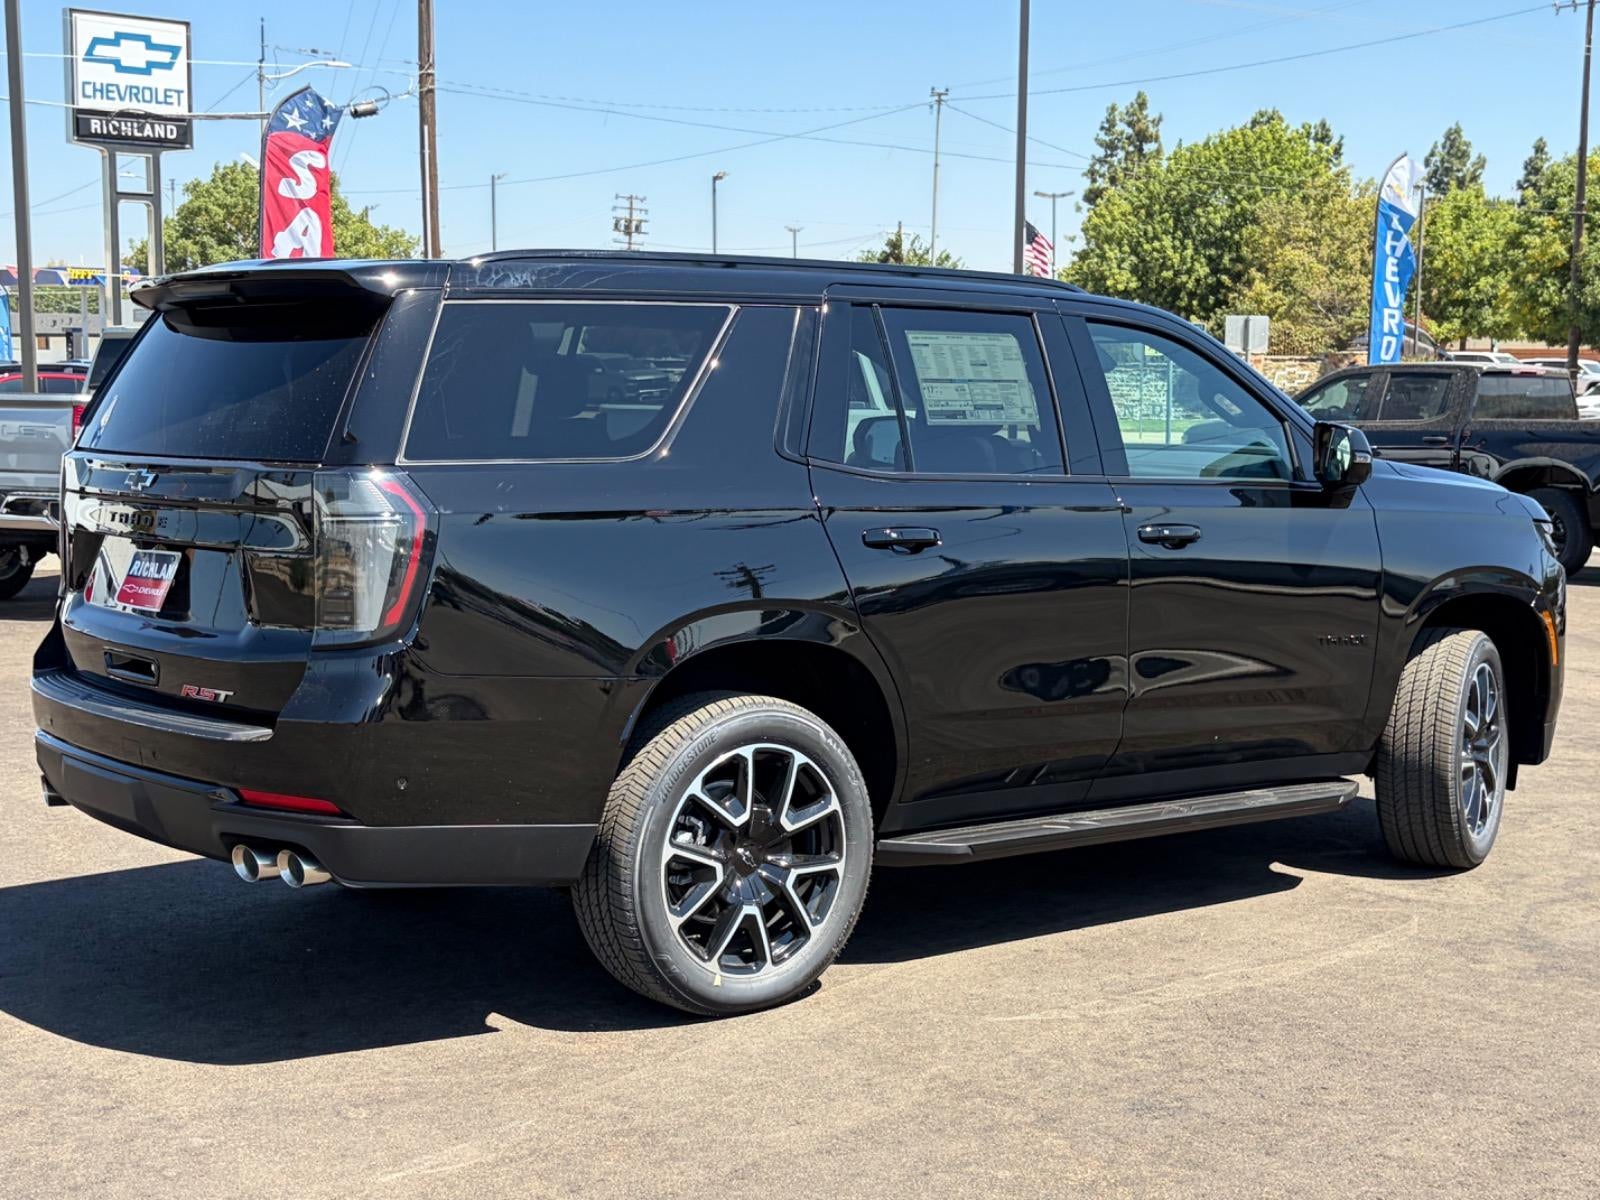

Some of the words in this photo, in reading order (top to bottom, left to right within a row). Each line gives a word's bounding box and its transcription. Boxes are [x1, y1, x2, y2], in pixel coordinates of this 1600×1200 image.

[82, 81, 184, 106] CHEVROLET
[90, 119, 177, 139] RICHLAND
[129, 560, 175, 579] RICHLAN
[181, 684, 234, 703] RST
